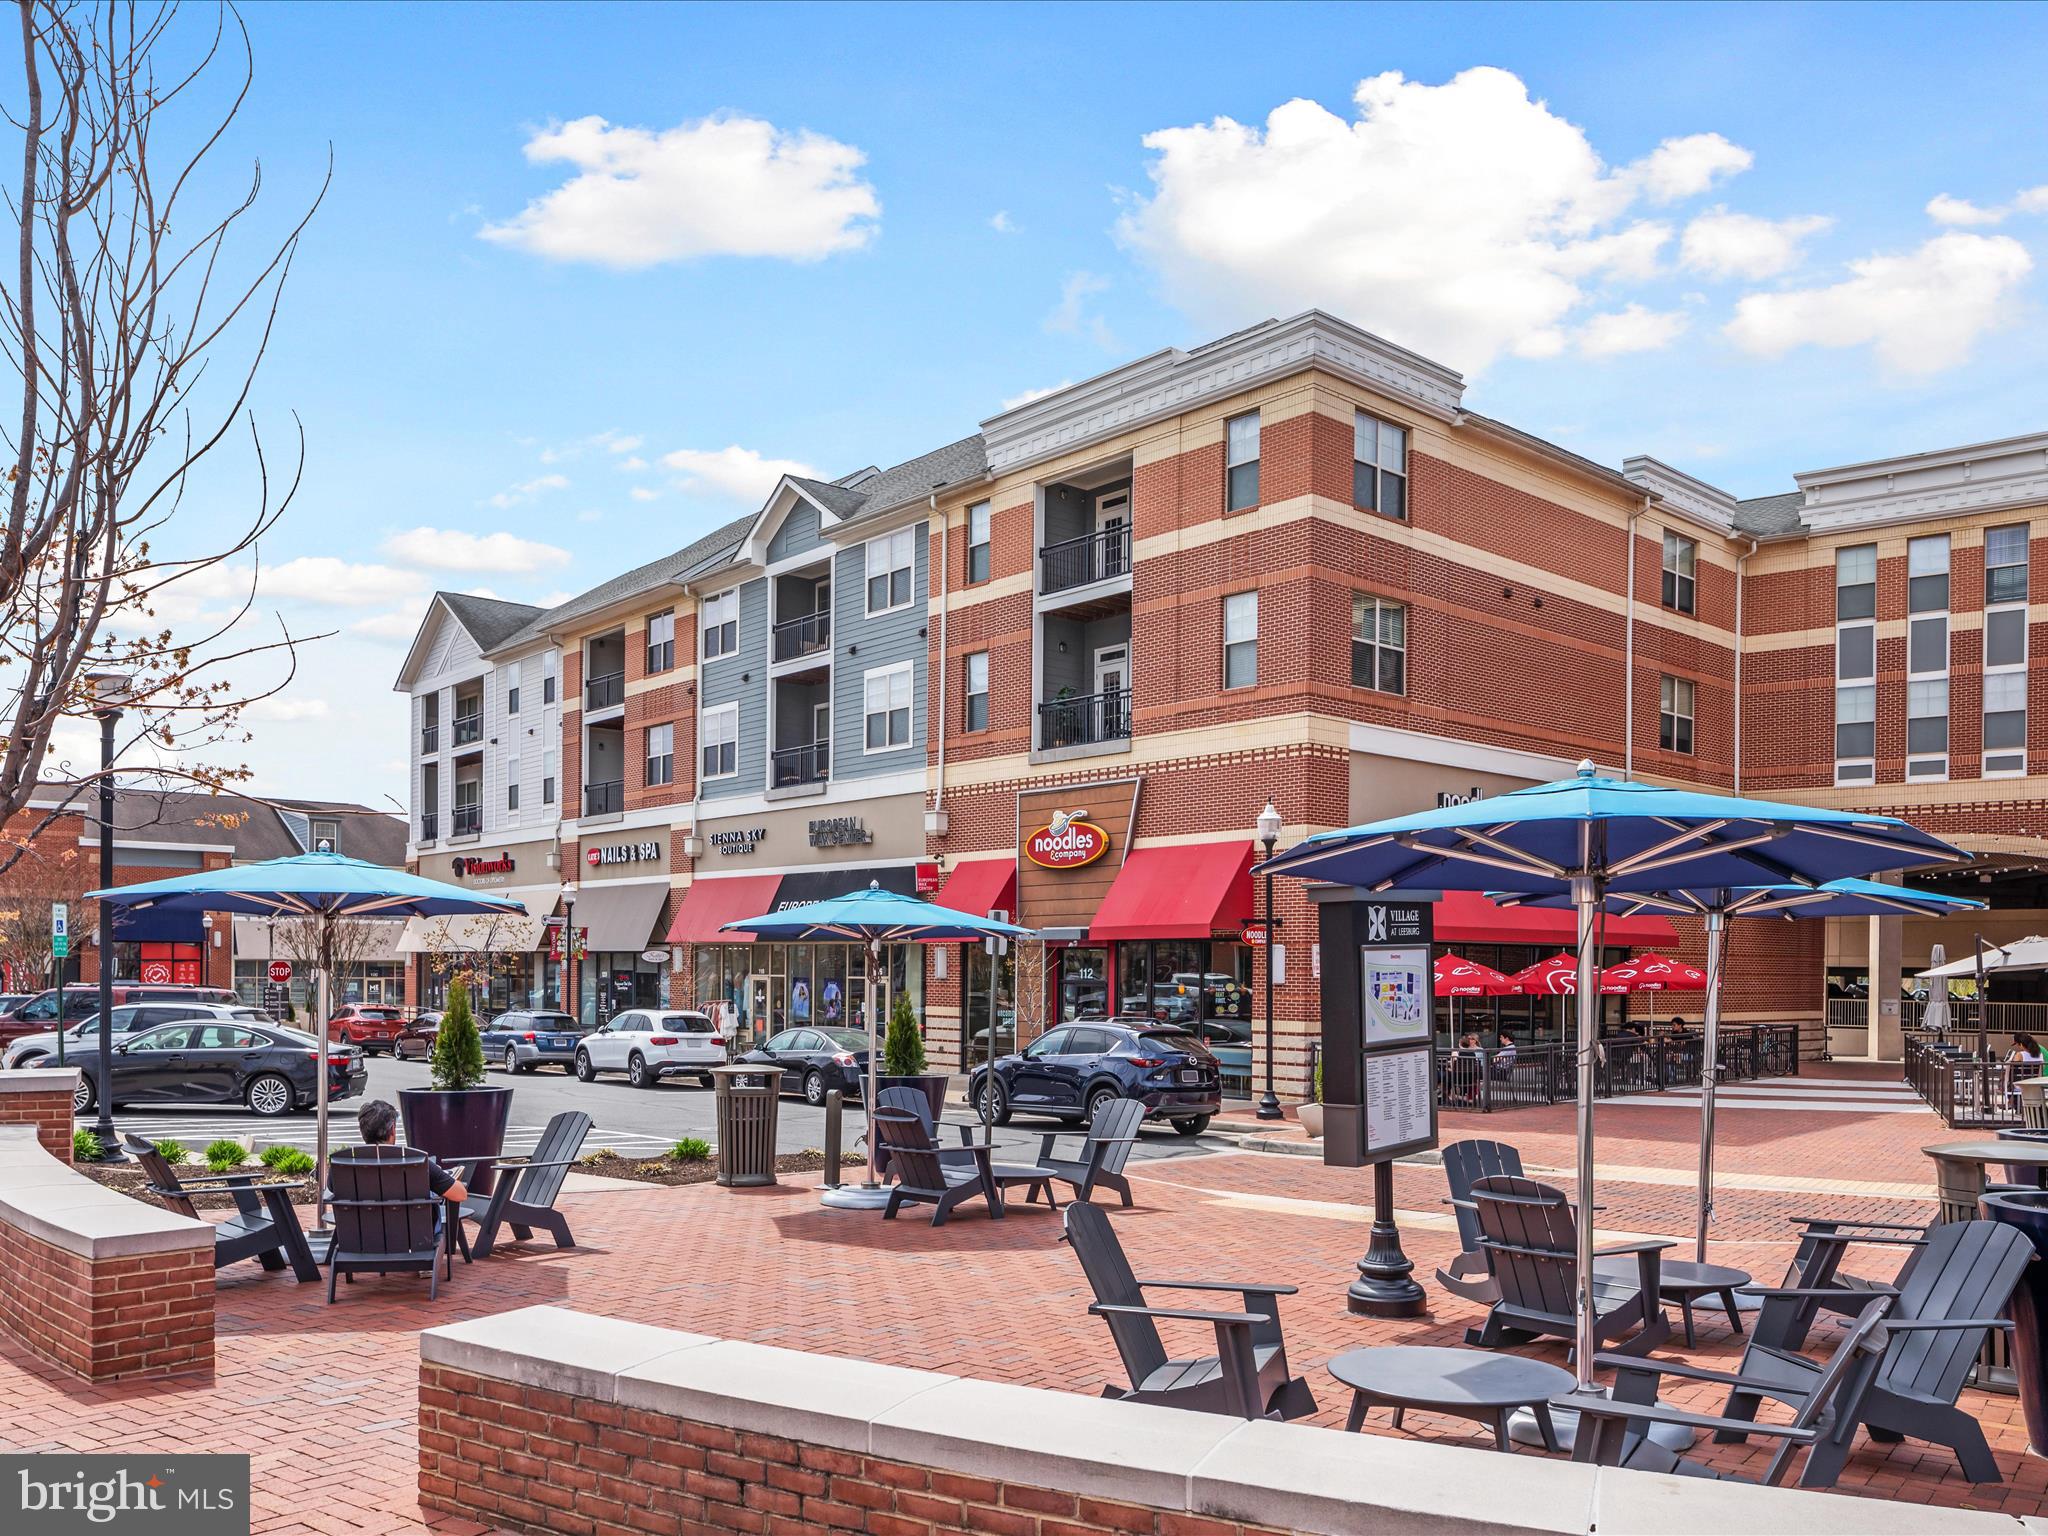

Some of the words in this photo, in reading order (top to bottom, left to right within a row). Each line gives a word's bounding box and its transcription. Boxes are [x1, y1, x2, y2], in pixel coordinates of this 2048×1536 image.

[809, 817, 856, 833] EUROPEAN
[709, 831, 743, 845] SIENNA
[747, 829, 763, 841] SKY
[809, 834, 831, 847] WAX
[832, 829, 866, 845] CENTER
[1035, 827, 1093, 852] noodles
[601, 845, 627, 864] NAILS
[630, 845, 636, 861] &
[640, 842, 657, 860] SPA
[719, 844, 752, 854] BOUTIQUE
[1050, 850, 1086, 861] &company
[1390, 910, 1419, 921] VILLAGE
[1391, 927, 1396, 935] AT
[1399, 927, 1419, 935] LEESBURG
[270, 967, 291, 976] STOP
[1080, 968, 1094, 979] 112
